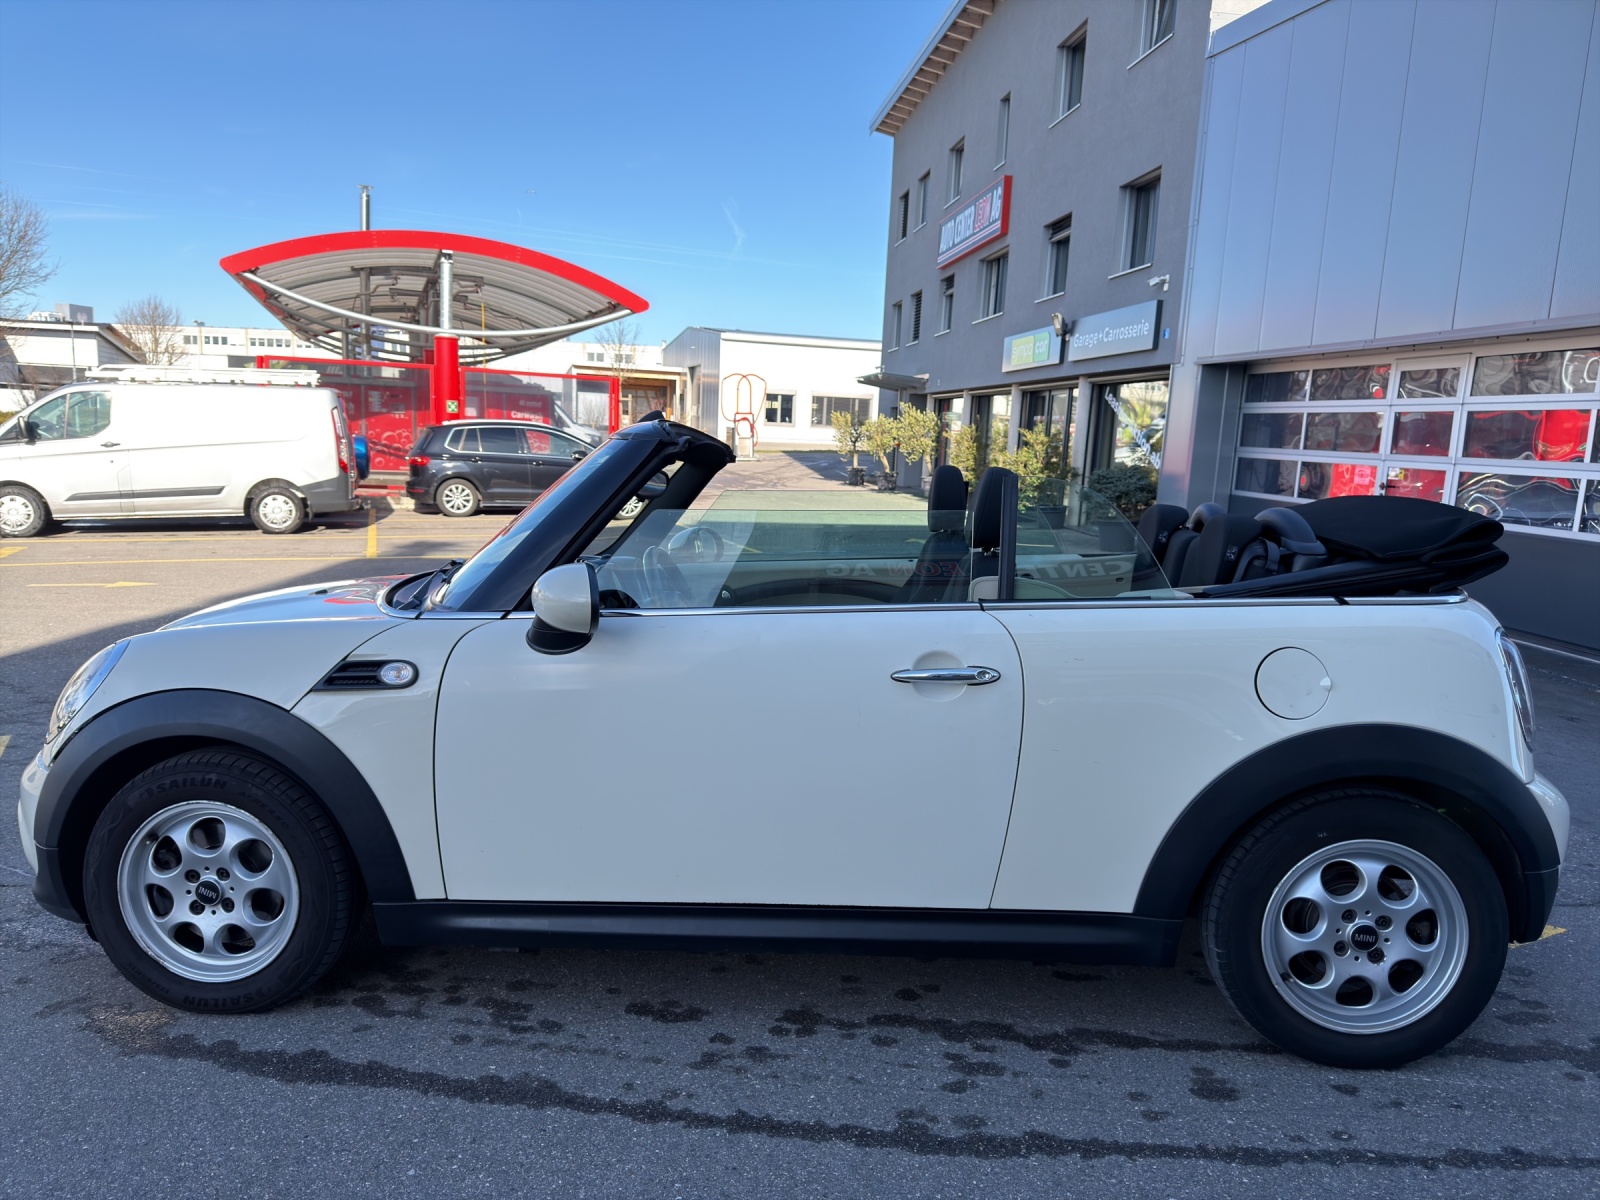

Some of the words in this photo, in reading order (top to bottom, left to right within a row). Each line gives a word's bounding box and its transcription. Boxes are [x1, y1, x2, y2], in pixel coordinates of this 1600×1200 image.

[155, 777, 227, 794] SAILUN
[198, 886, 217, 900] MINI
[1354, 933, 1376, 943] MINI
